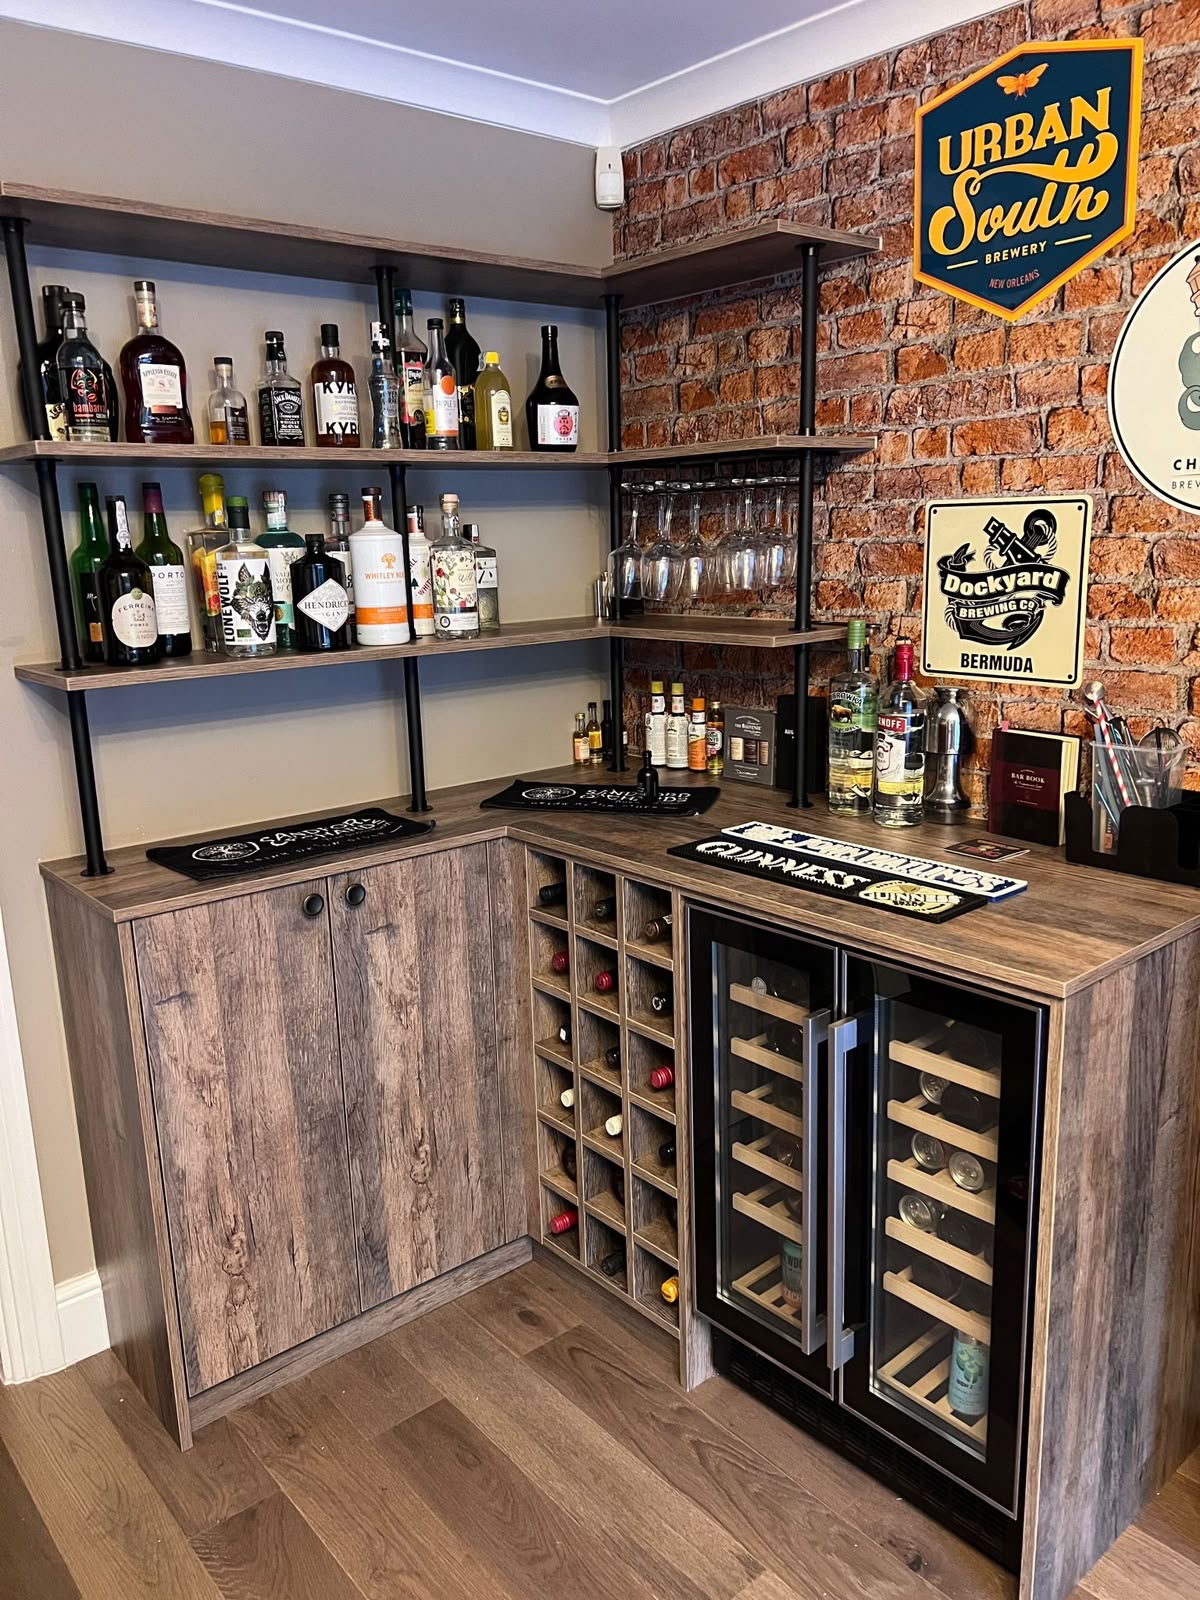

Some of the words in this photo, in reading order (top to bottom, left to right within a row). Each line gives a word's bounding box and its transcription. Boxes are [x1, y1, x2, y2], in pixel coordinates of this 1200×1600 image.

[938, 86, 1112, 175] URBAN
[928, 132, 1119, 256] South
[985, 240, 1047, 265] BREWERY
[989, 278, 1005, 289] NEW
[1006, 269, 1040, 289] ORLEANS
[142, 369, 163, 377] APPLETON
[273, 394, 285, 405] JACK
[364, 572, 394, 580] WHITLEY
[943, 571, 1061, 596] Dockyard
[218, 572, 236, 642] LONEWOLF
[959, 600, 1017, 619] BREWING
[960, 653, 1034, 673] BERMUDA
[1011, 772, 1024, 780] BAR
[1026, 775, 1045, 784] BOOK
[696, 841, 871, 889] GUINNESS
[859, 890, 962, 905] GUINNESS
